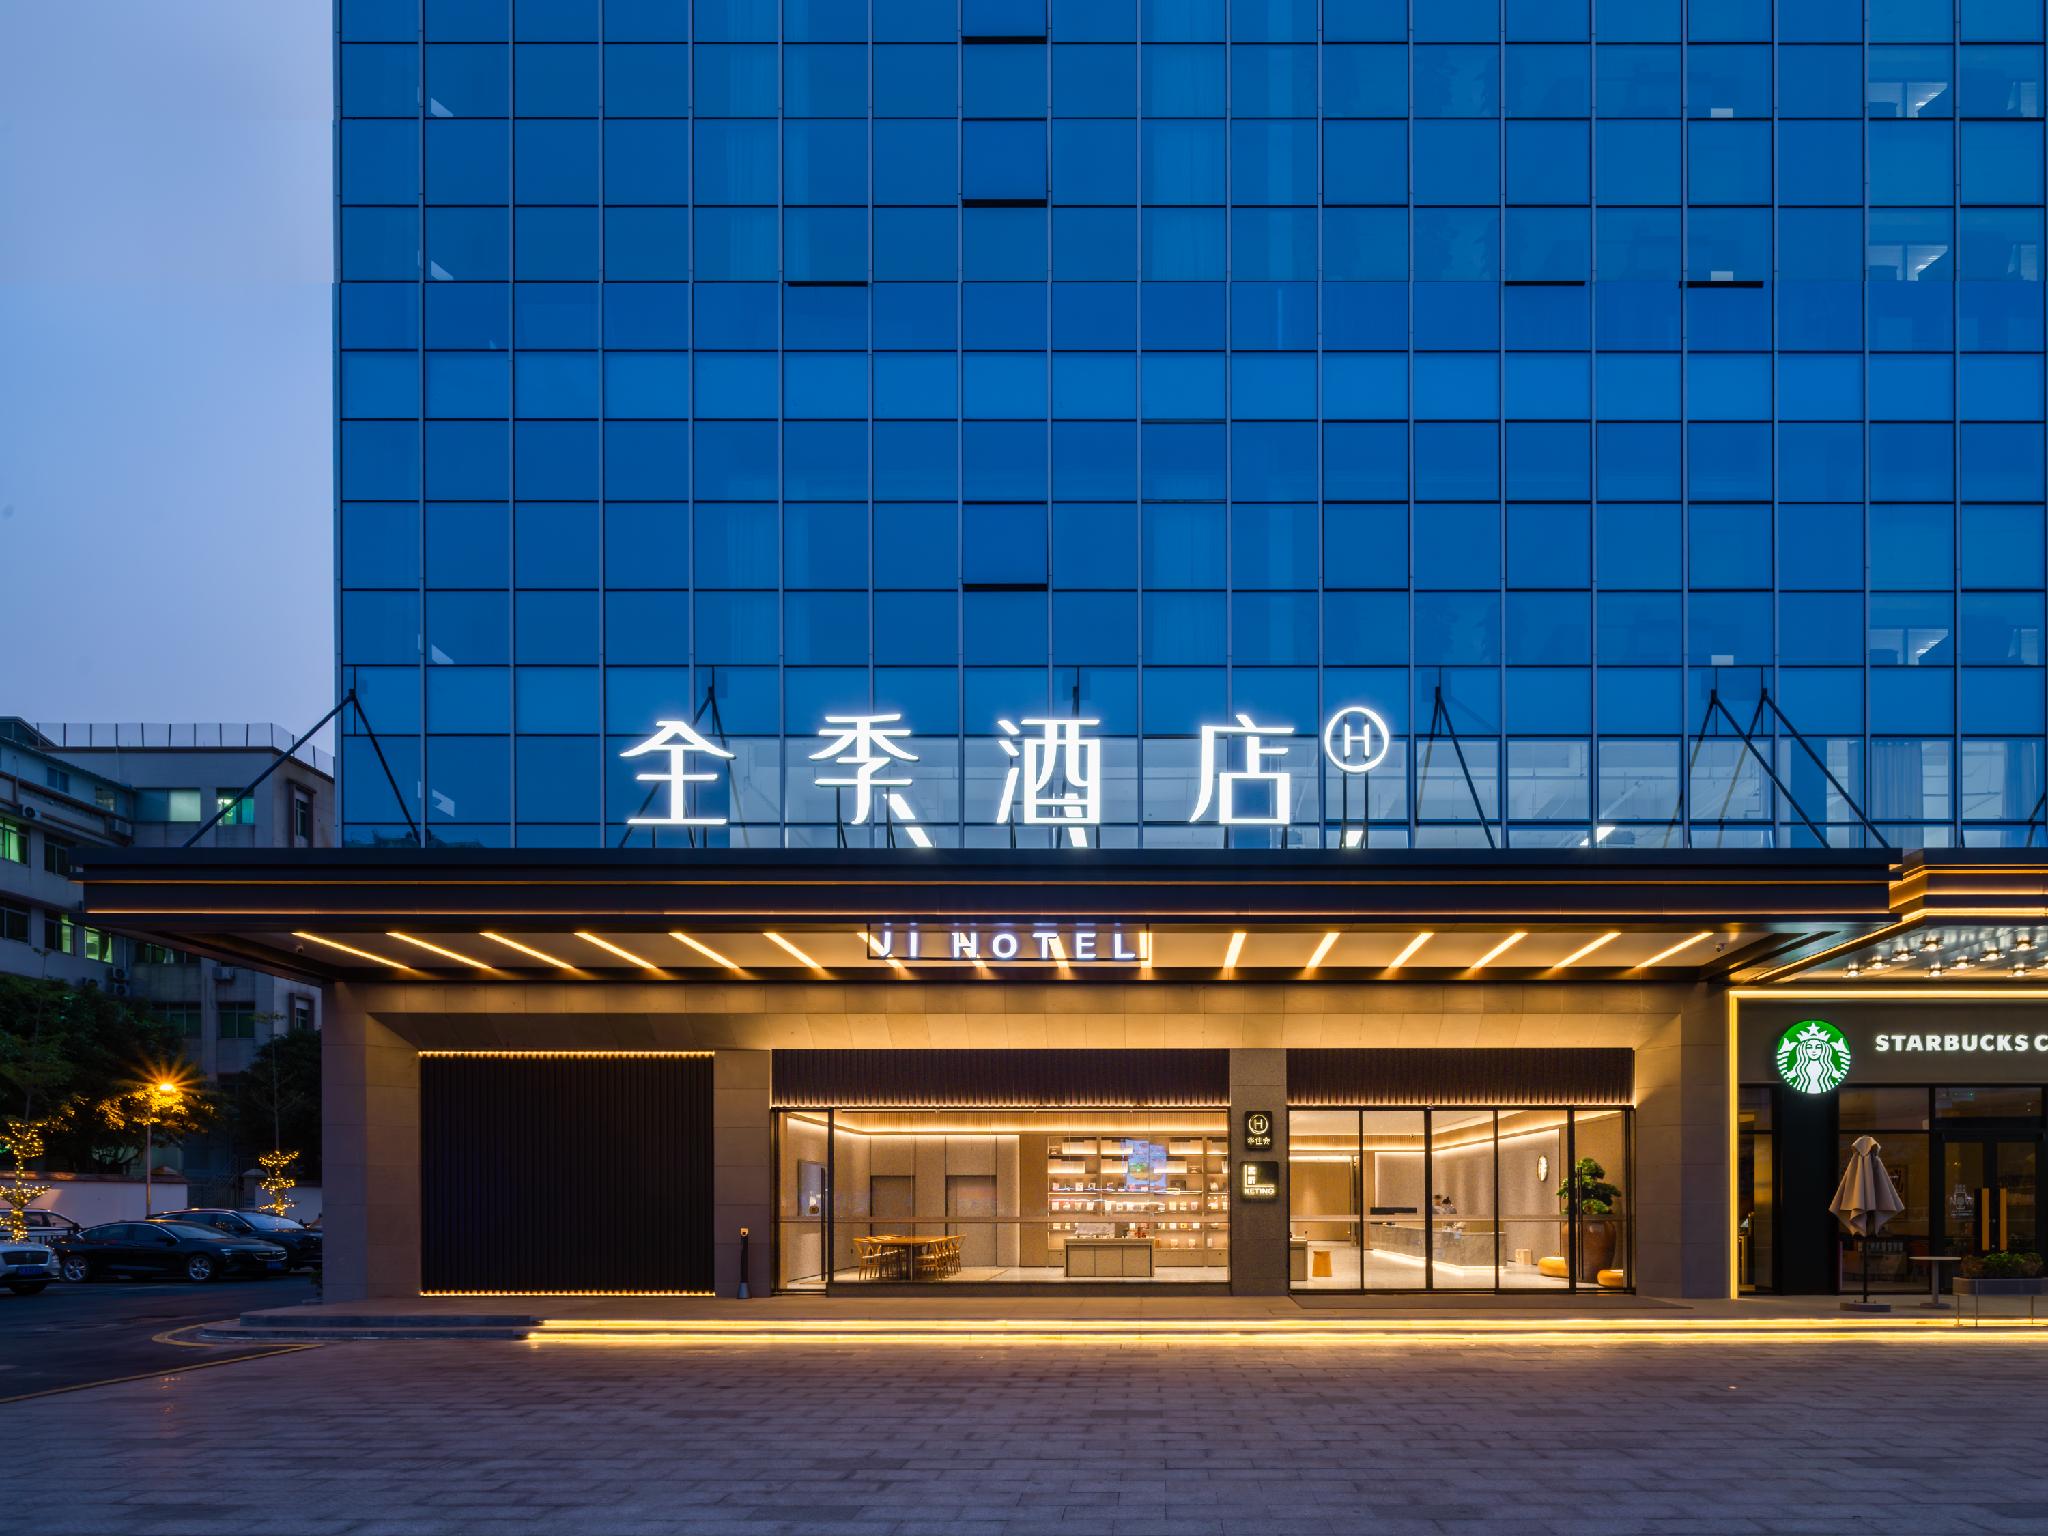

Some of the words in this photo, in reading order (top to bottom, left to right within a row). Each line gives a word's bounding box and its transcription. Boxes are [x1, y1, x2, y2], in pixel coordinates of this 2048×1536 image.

[619, 713, 1296, 827] 全季酒店
[952, 931, 1136, 959] HOTEL
[1874, 1033, 2029, 1052] STARBUCKS
